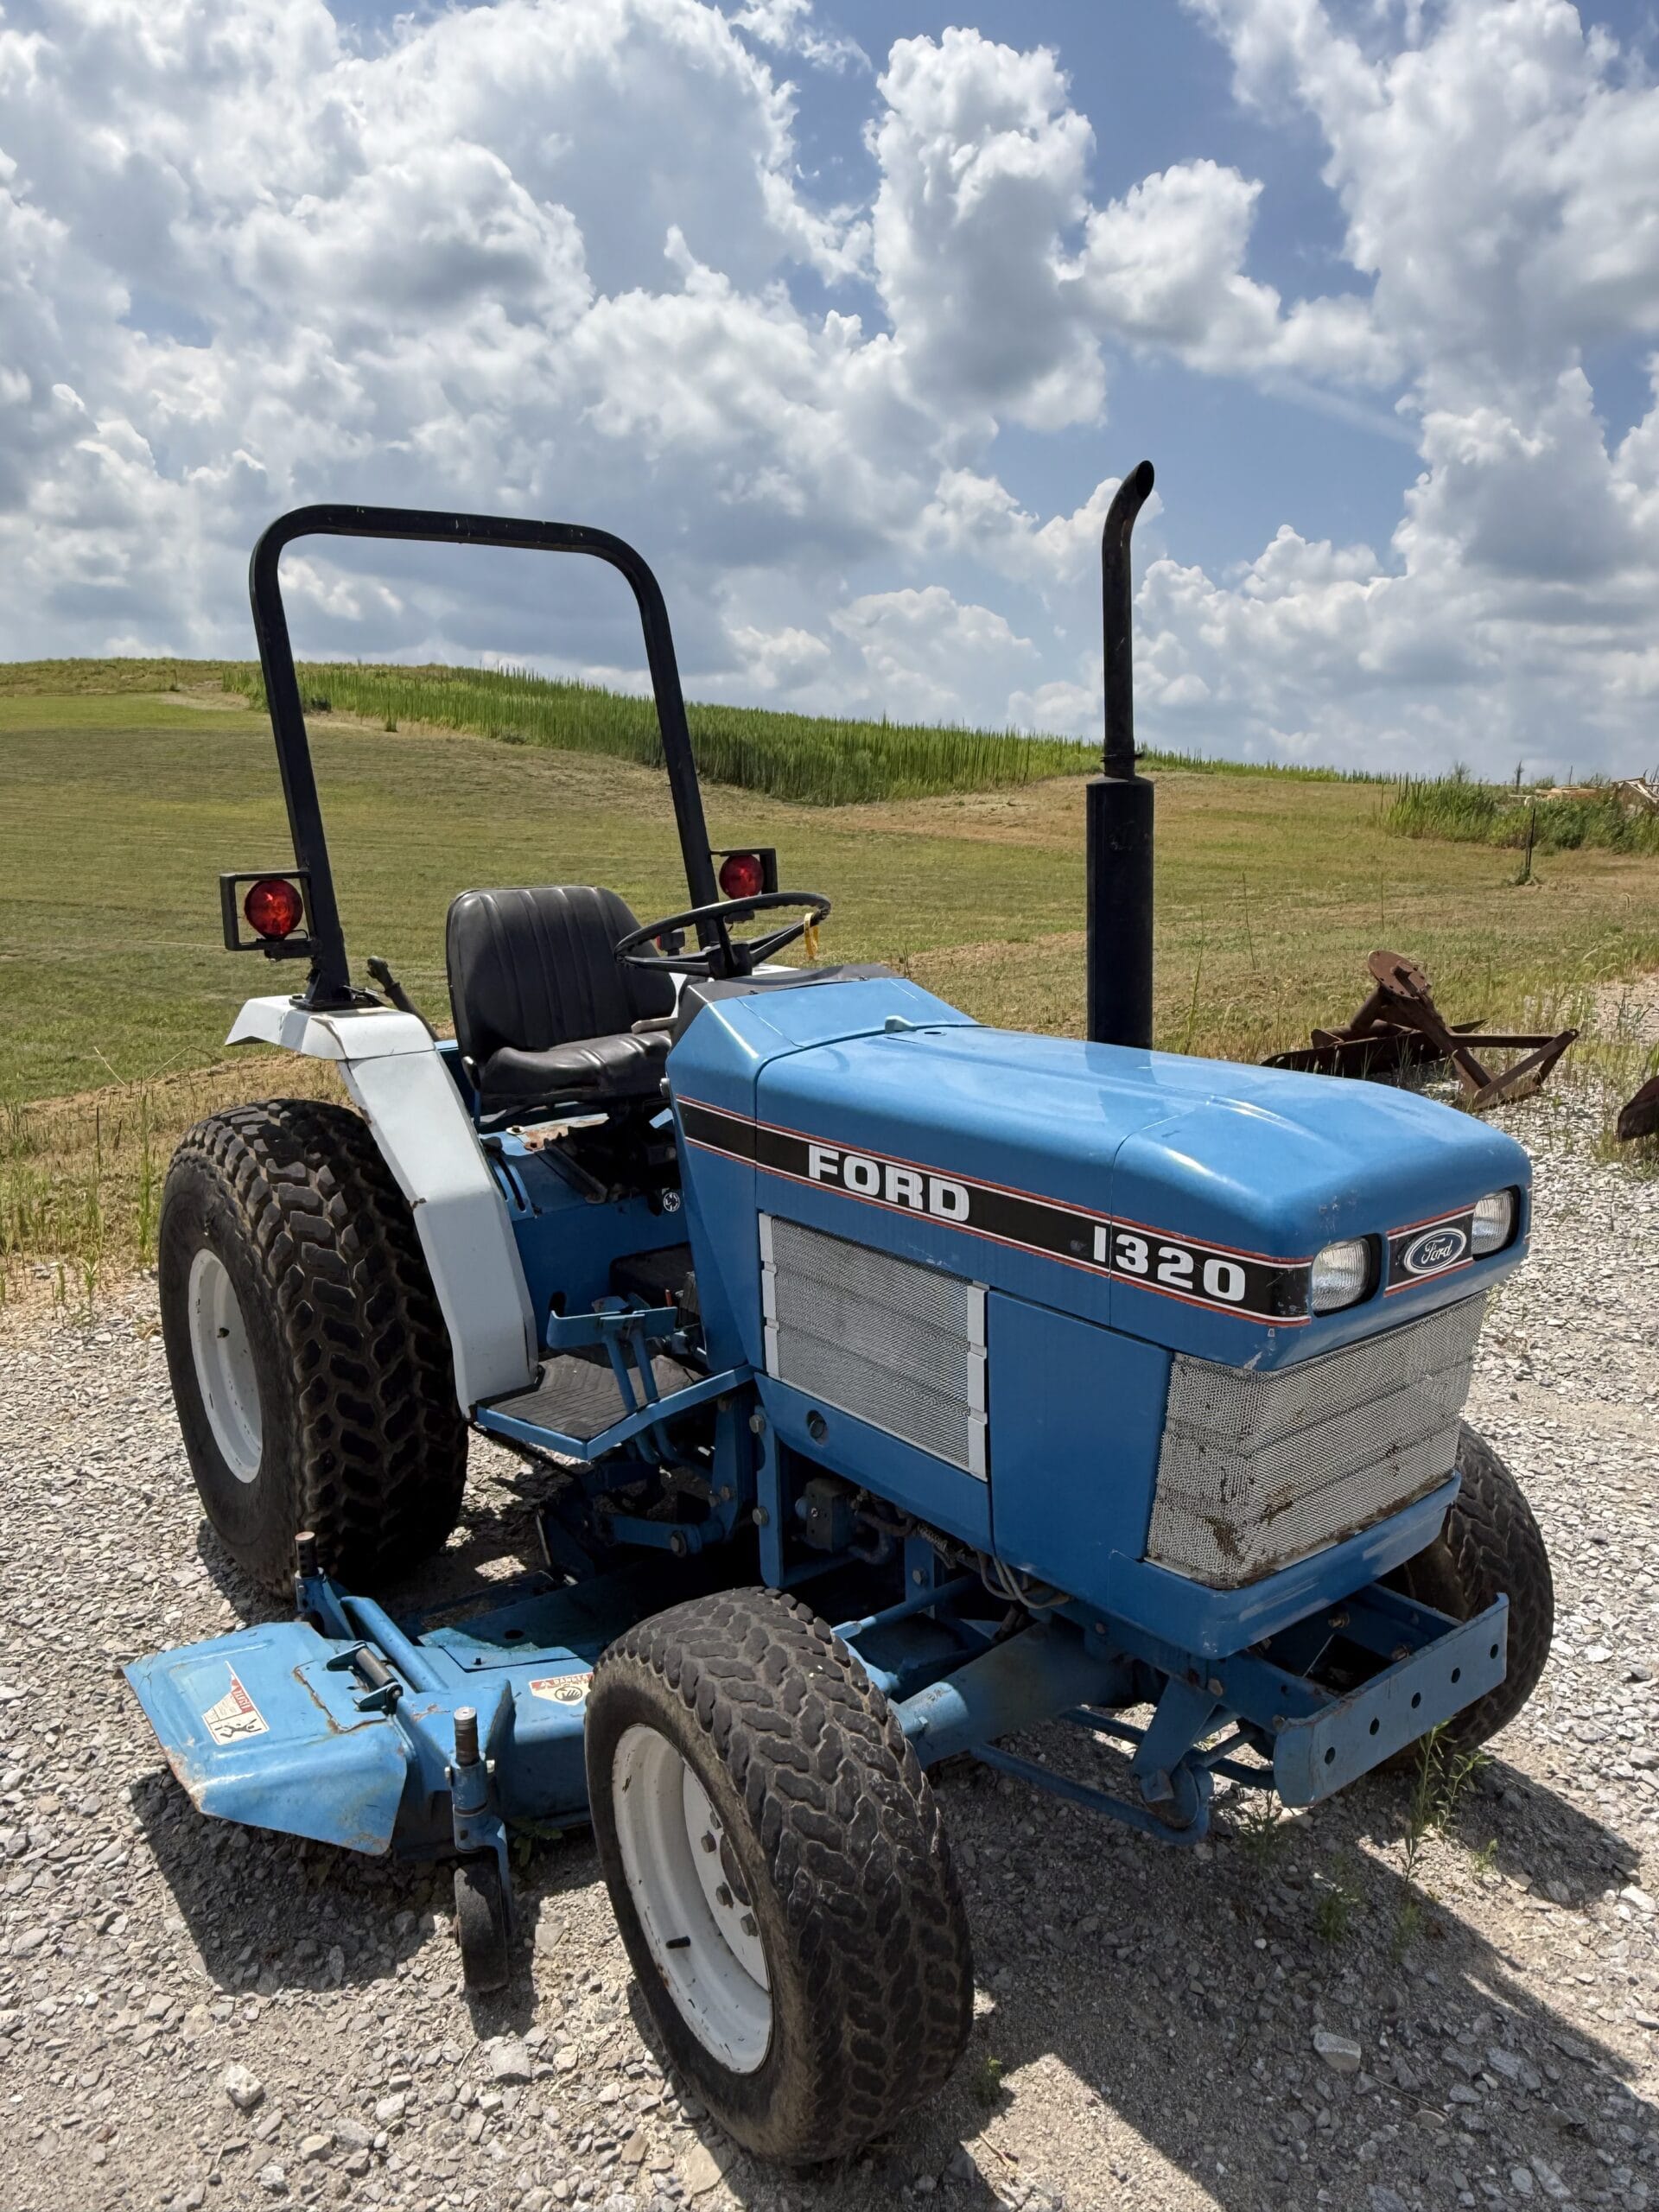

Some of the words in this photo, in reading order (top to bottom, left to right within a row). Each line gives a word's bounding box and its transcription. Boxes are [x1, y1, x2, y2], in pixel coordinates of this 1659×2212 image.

[808, 1144, 969, 1222] FORD
[1094, 1225, 1246, 1301] 1320
[1421, 1237, 1453, 1264] Ford
